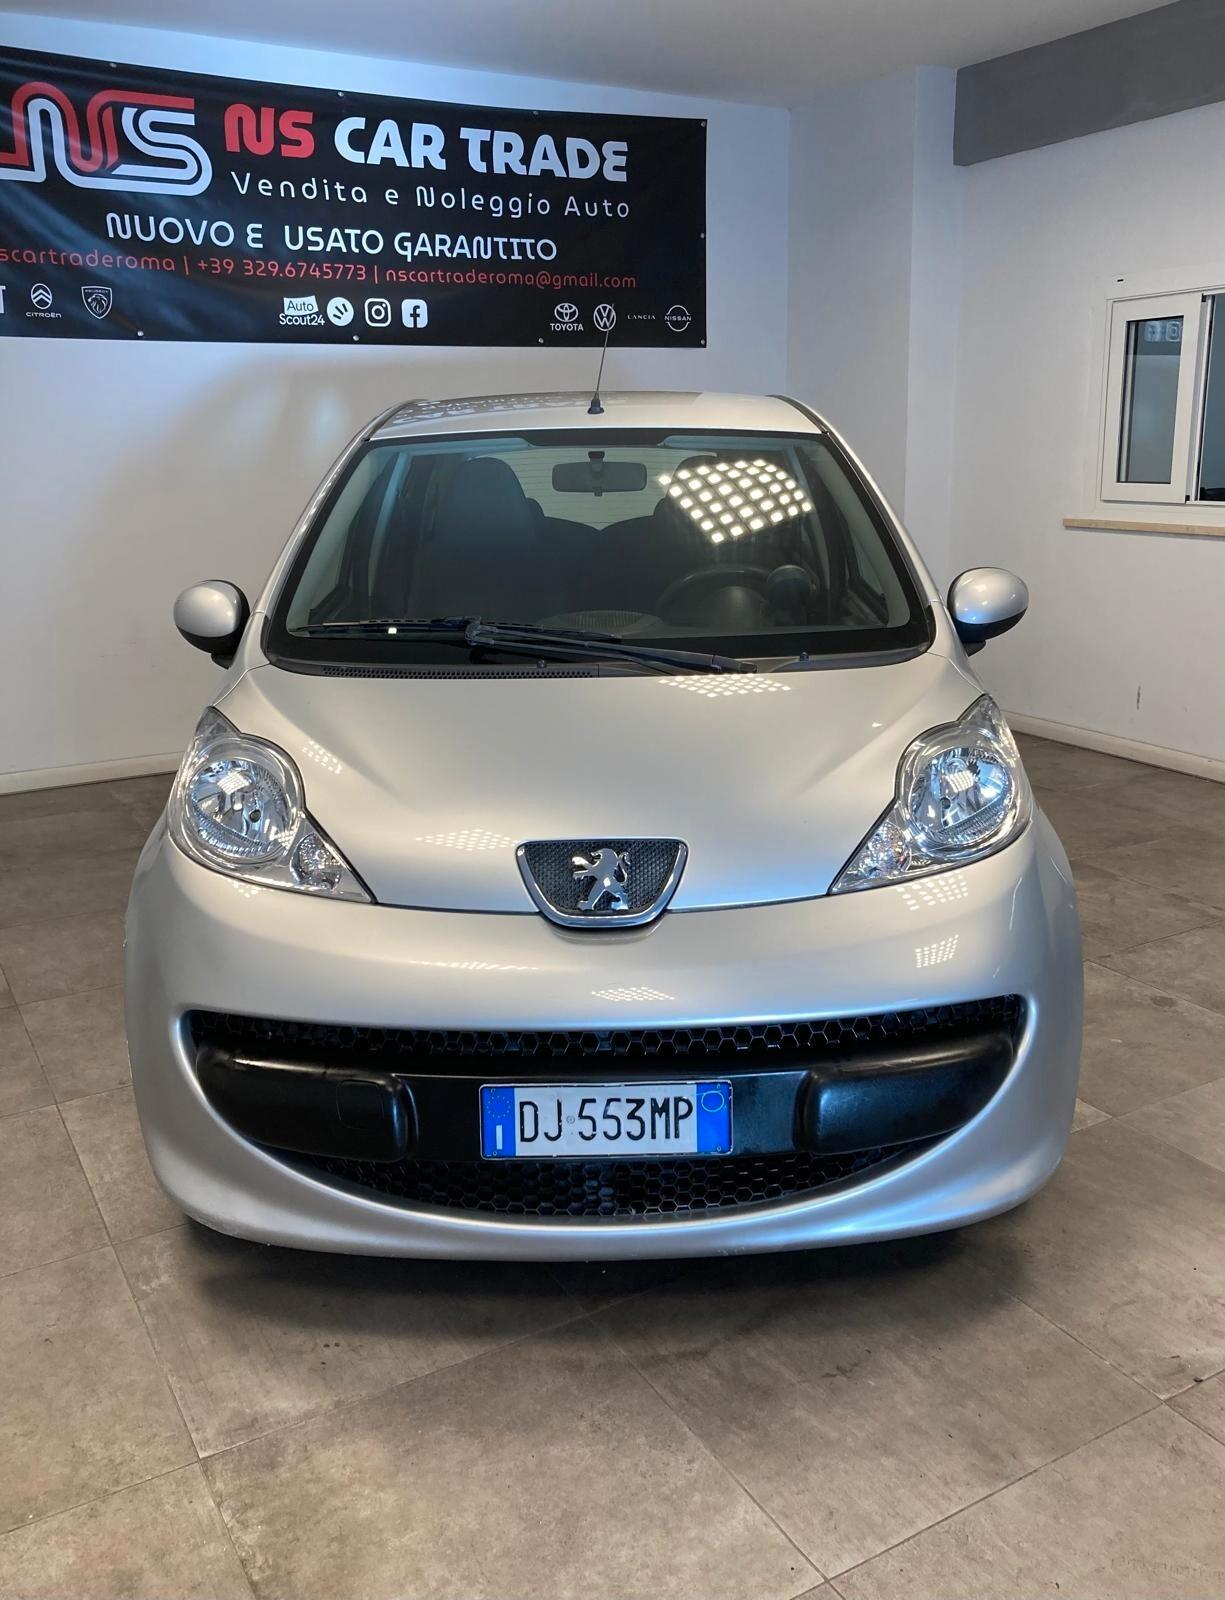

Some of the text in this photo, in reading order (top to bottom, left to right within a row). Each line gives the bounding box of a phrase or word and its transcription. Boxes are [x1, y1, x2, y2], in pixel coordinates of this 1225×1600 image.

[224, 103, 629, 183] NS CAR TRADE
[230, 171, 630, 218] Vendita e Noleggio Auto
[105, 212, 558, 263] NUOVO E USATO GARANTITO
[198, 257, 235, 275] +39
[242, 258, 367, 281] 329.6745773
[385, 268, 636, 290] nscartraderoma@gmail.com
[286, 300, 314, 312] Auto
[627, 313, 656, 321] LANCIA
[279, 313, 326, 326] Scout24
[550, 323, 584, 332] TOYOTA
[664, 314, 692, 322] NISSAN
[518, 1095, 694, 1143] DJ 553MP
